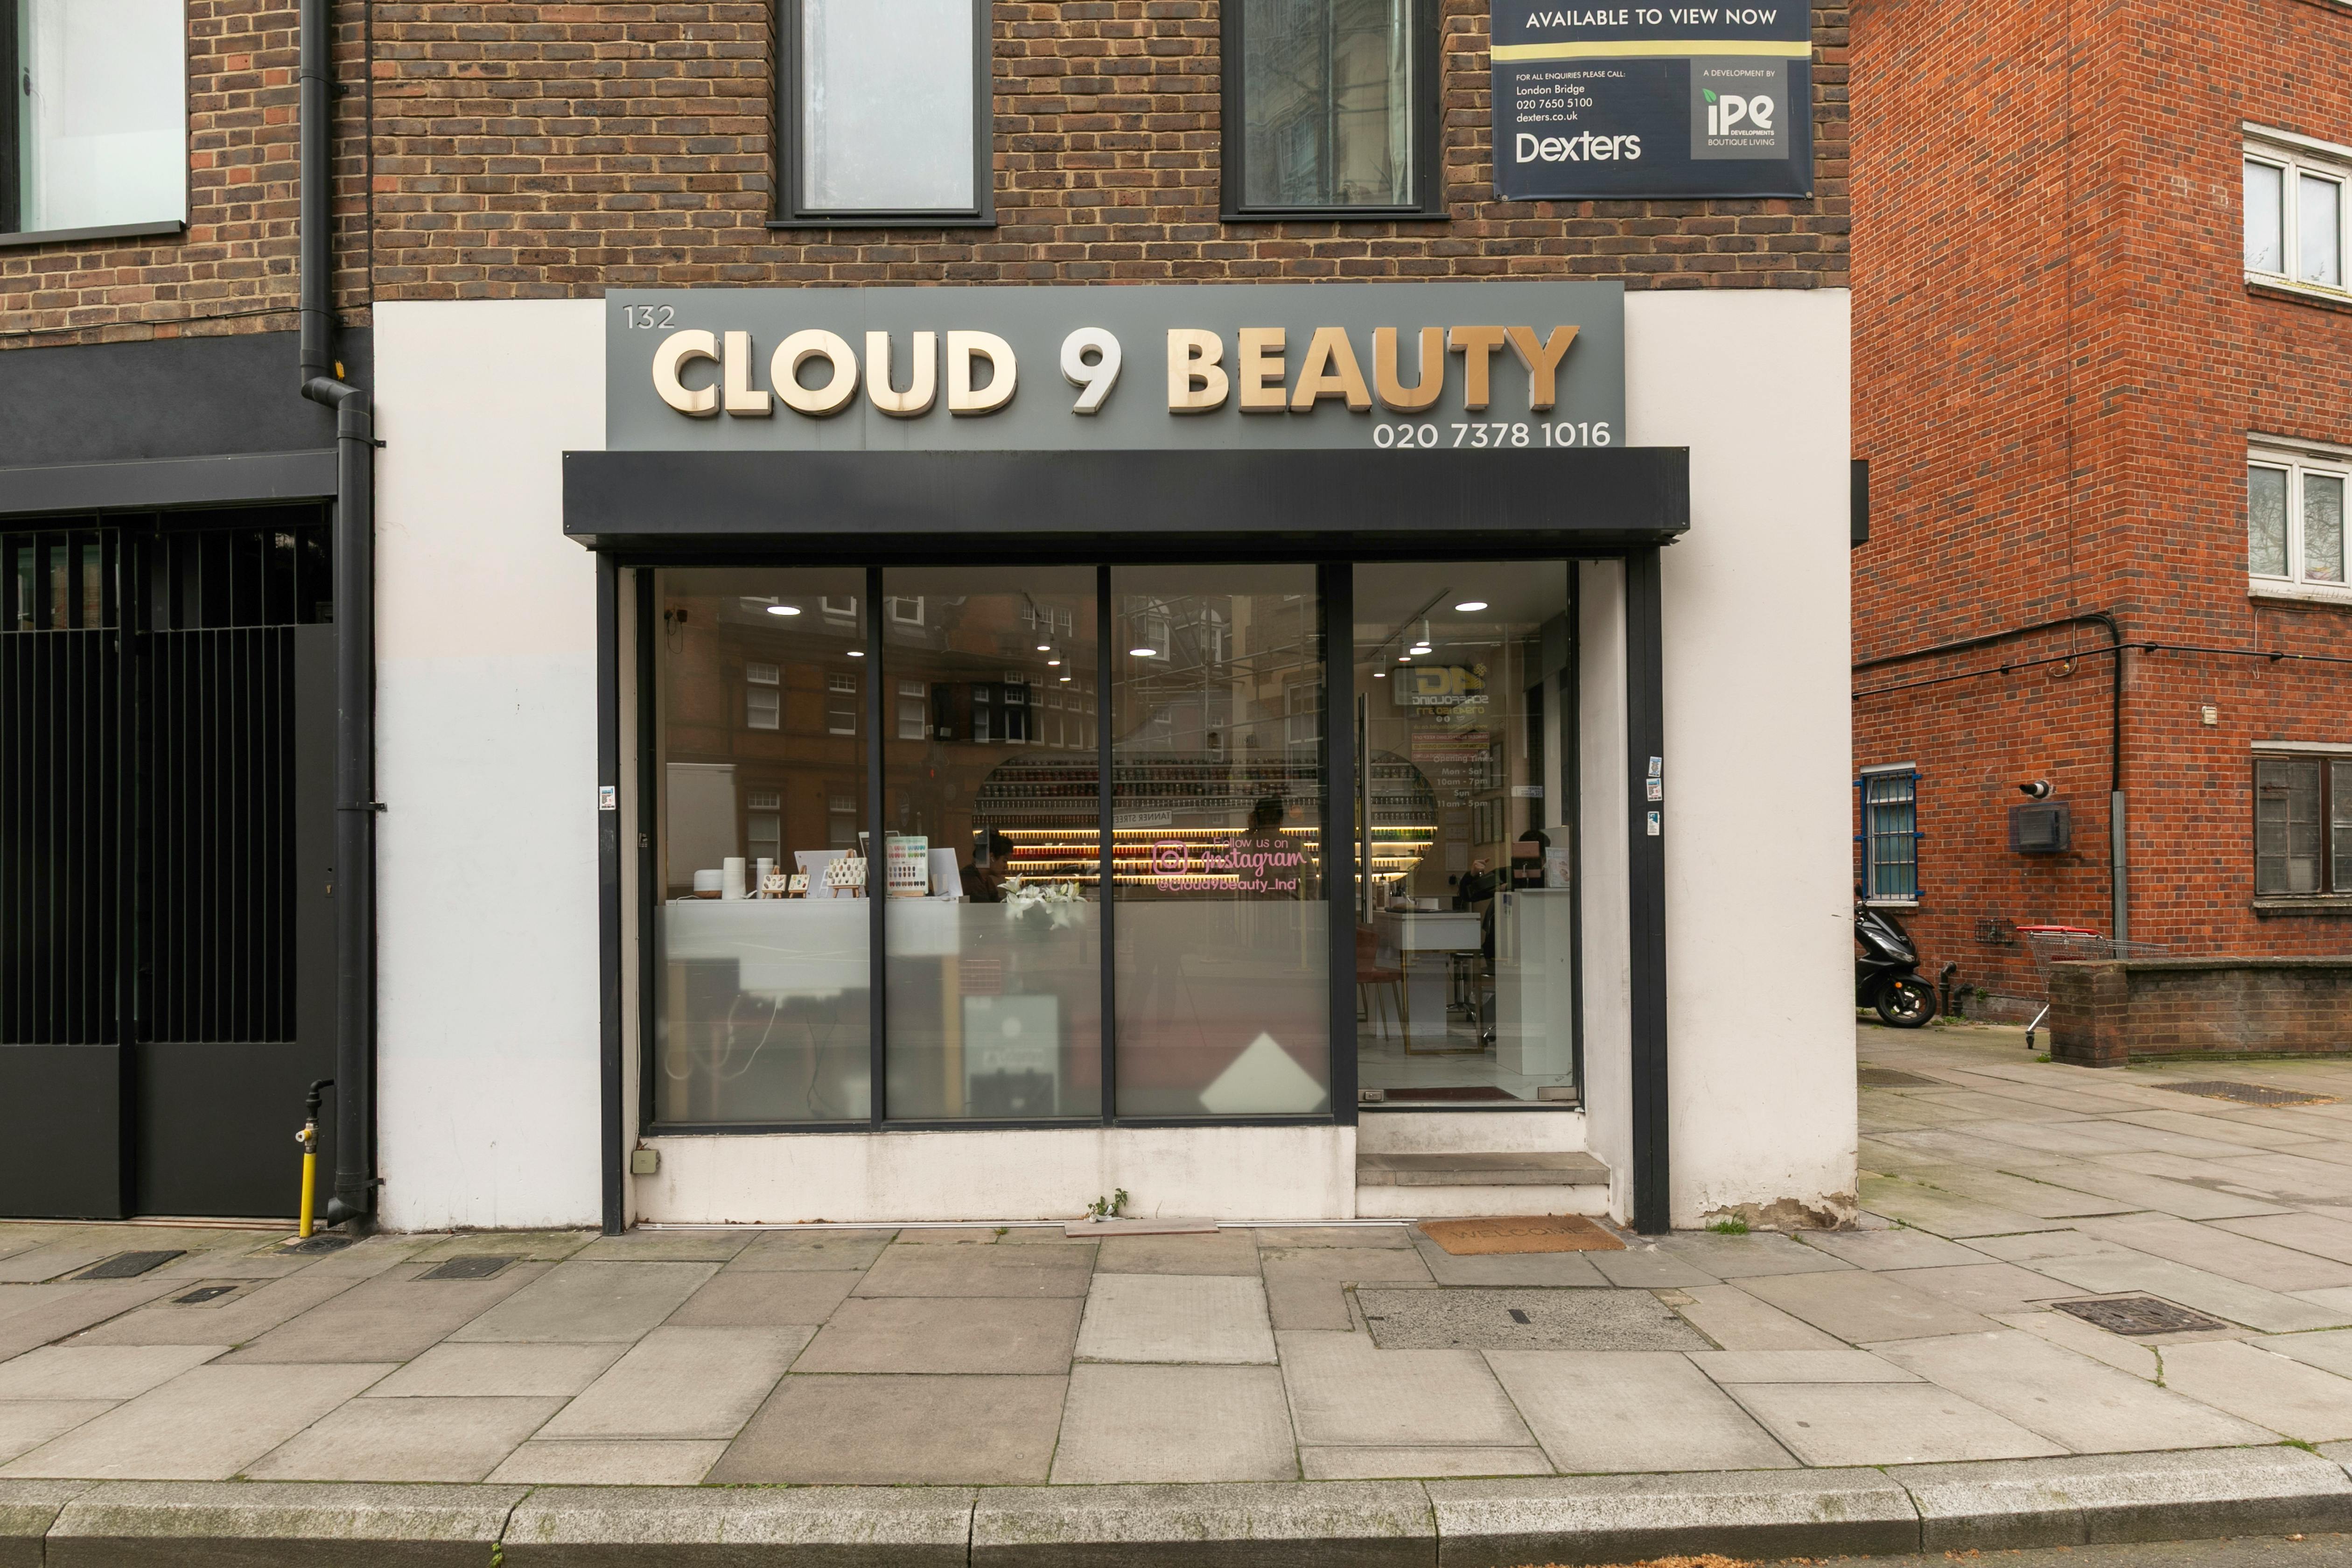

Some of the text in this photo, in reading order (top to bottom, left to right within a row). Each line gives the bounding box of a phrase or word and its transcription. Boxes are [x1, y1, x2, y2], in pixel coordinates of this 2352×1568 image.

[1526, 8, 1777, 28] AVAILABLE TO VIEW NOW
[1516, 84, 1585, 95] London Bridge
[1516, 98, 1592, 110] 020 7650 5100
[1516, 111, 1578, 122] dexters.co.uk
[1516, 131, 1641, 163] Dexters
[622, 304, 676, 329] 132
[652, 324, 1581, 418] CLOUD 9 BEAUTY
[1372, 421, 1611, 449] 020 7378 1016
[1469, 778, 1488, 786] 7pm
[1468, 800, 1488, 809] 5pm
[1213, 837, 1288, 849] Follow us on
[1201, 848, 1307, 877] Instagram
[1449, 1226, 1589, 1239] WELCOME
